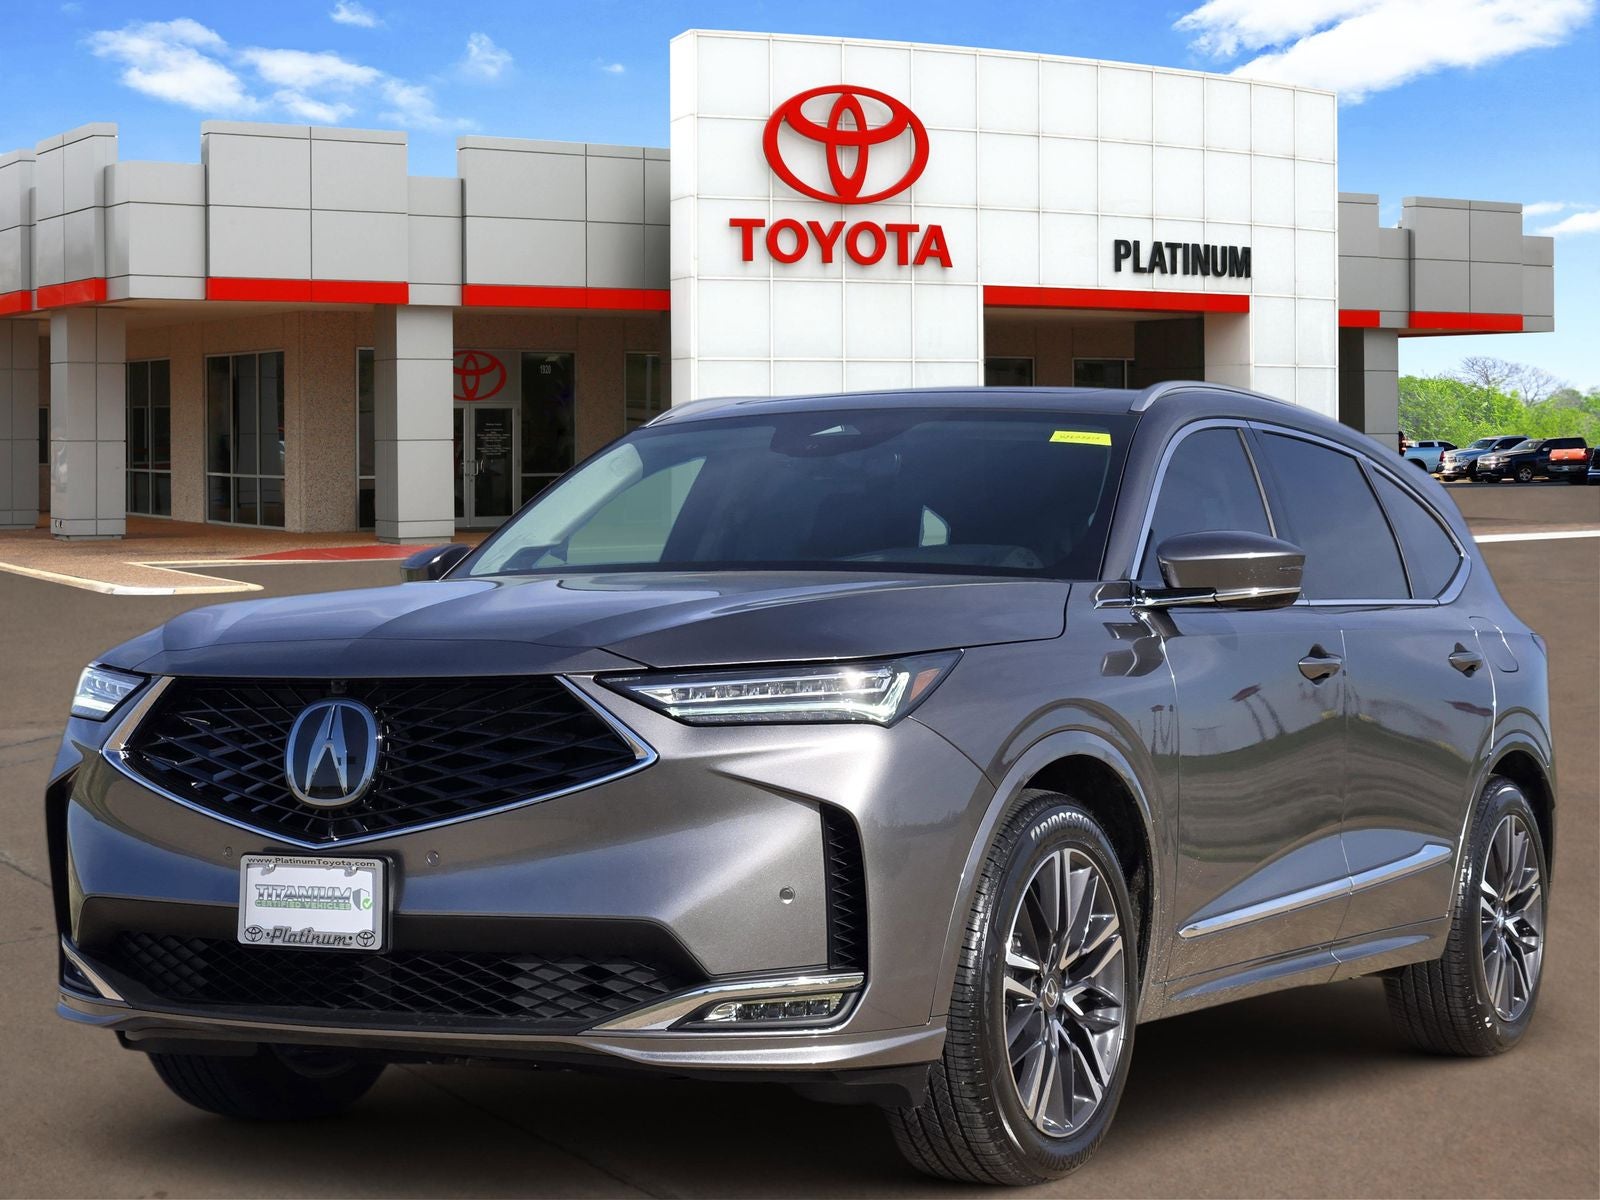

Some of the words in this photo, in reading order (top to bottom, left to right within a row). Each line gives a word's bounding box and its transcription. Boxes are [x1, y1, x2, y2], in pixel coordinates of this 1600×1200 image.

[729, 218, 953, 268] TOYOTA
[1114, 239, 1252, 278] PLATINUM
[247, 857, 376, 867] www.PlatinumToyota.com
[255, 884, 352, 900] TITANIUM
[255, 900, 301, 909] CERTIFIED
[303, 901, 352, 911] VEHICLES
[269, 926, 353, 946] Platinum
